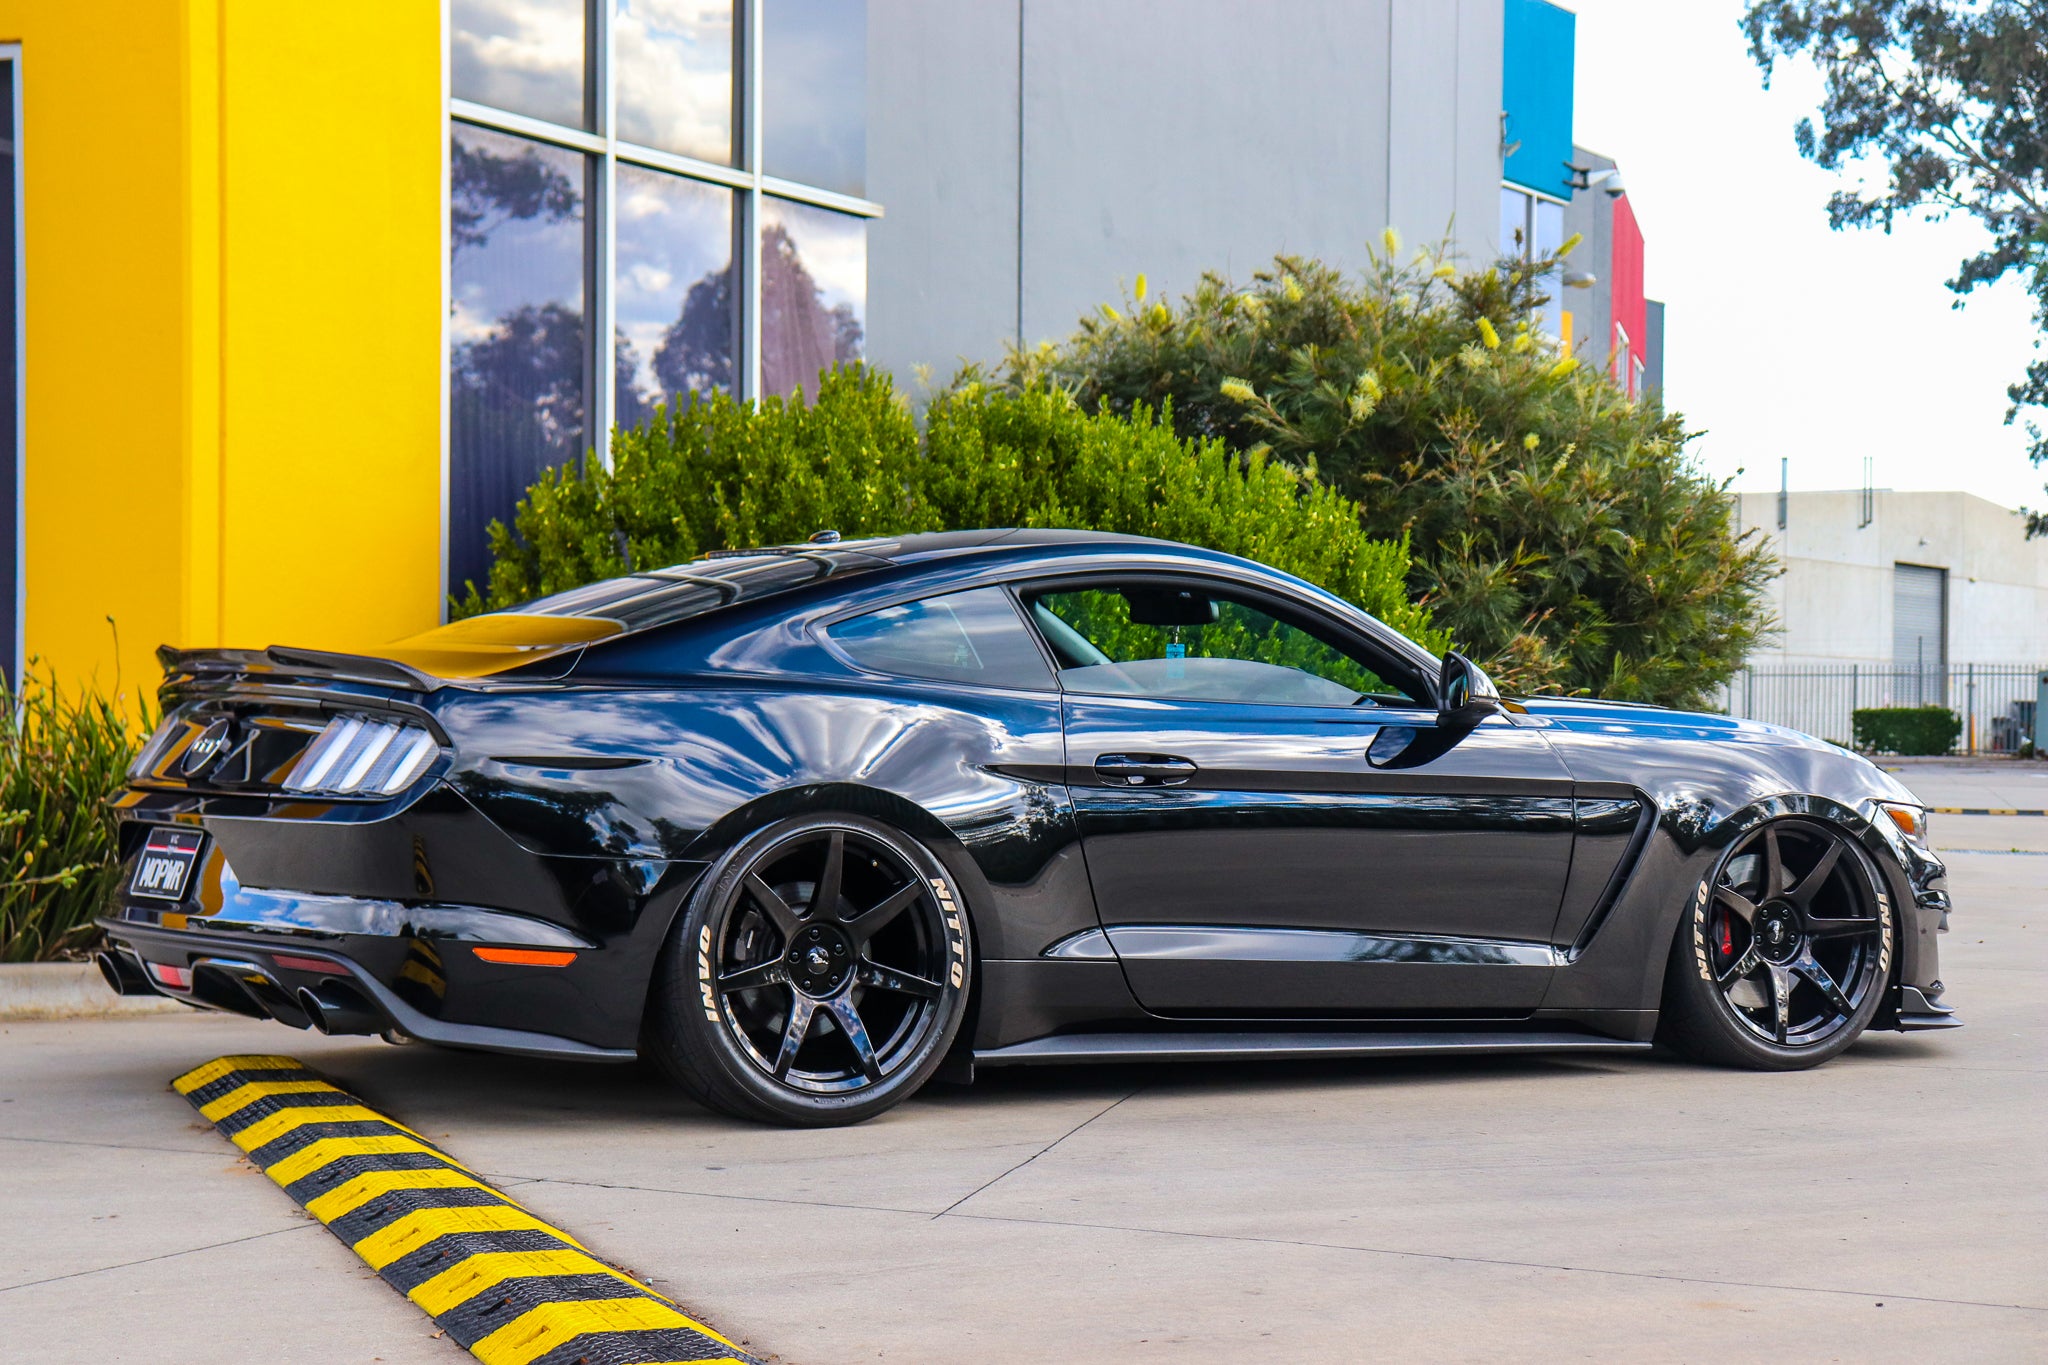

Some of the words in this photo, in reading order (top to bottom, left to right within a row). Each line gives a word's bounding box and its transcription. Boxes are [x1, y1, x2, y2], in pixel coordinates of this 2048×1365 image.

[699, 924, 720, 1022] INVO
[930, 878, 964, 989] NITTO
[1693, 880, 1712, 980] NITTO
[1877, 892, 1891, 973] INVO
